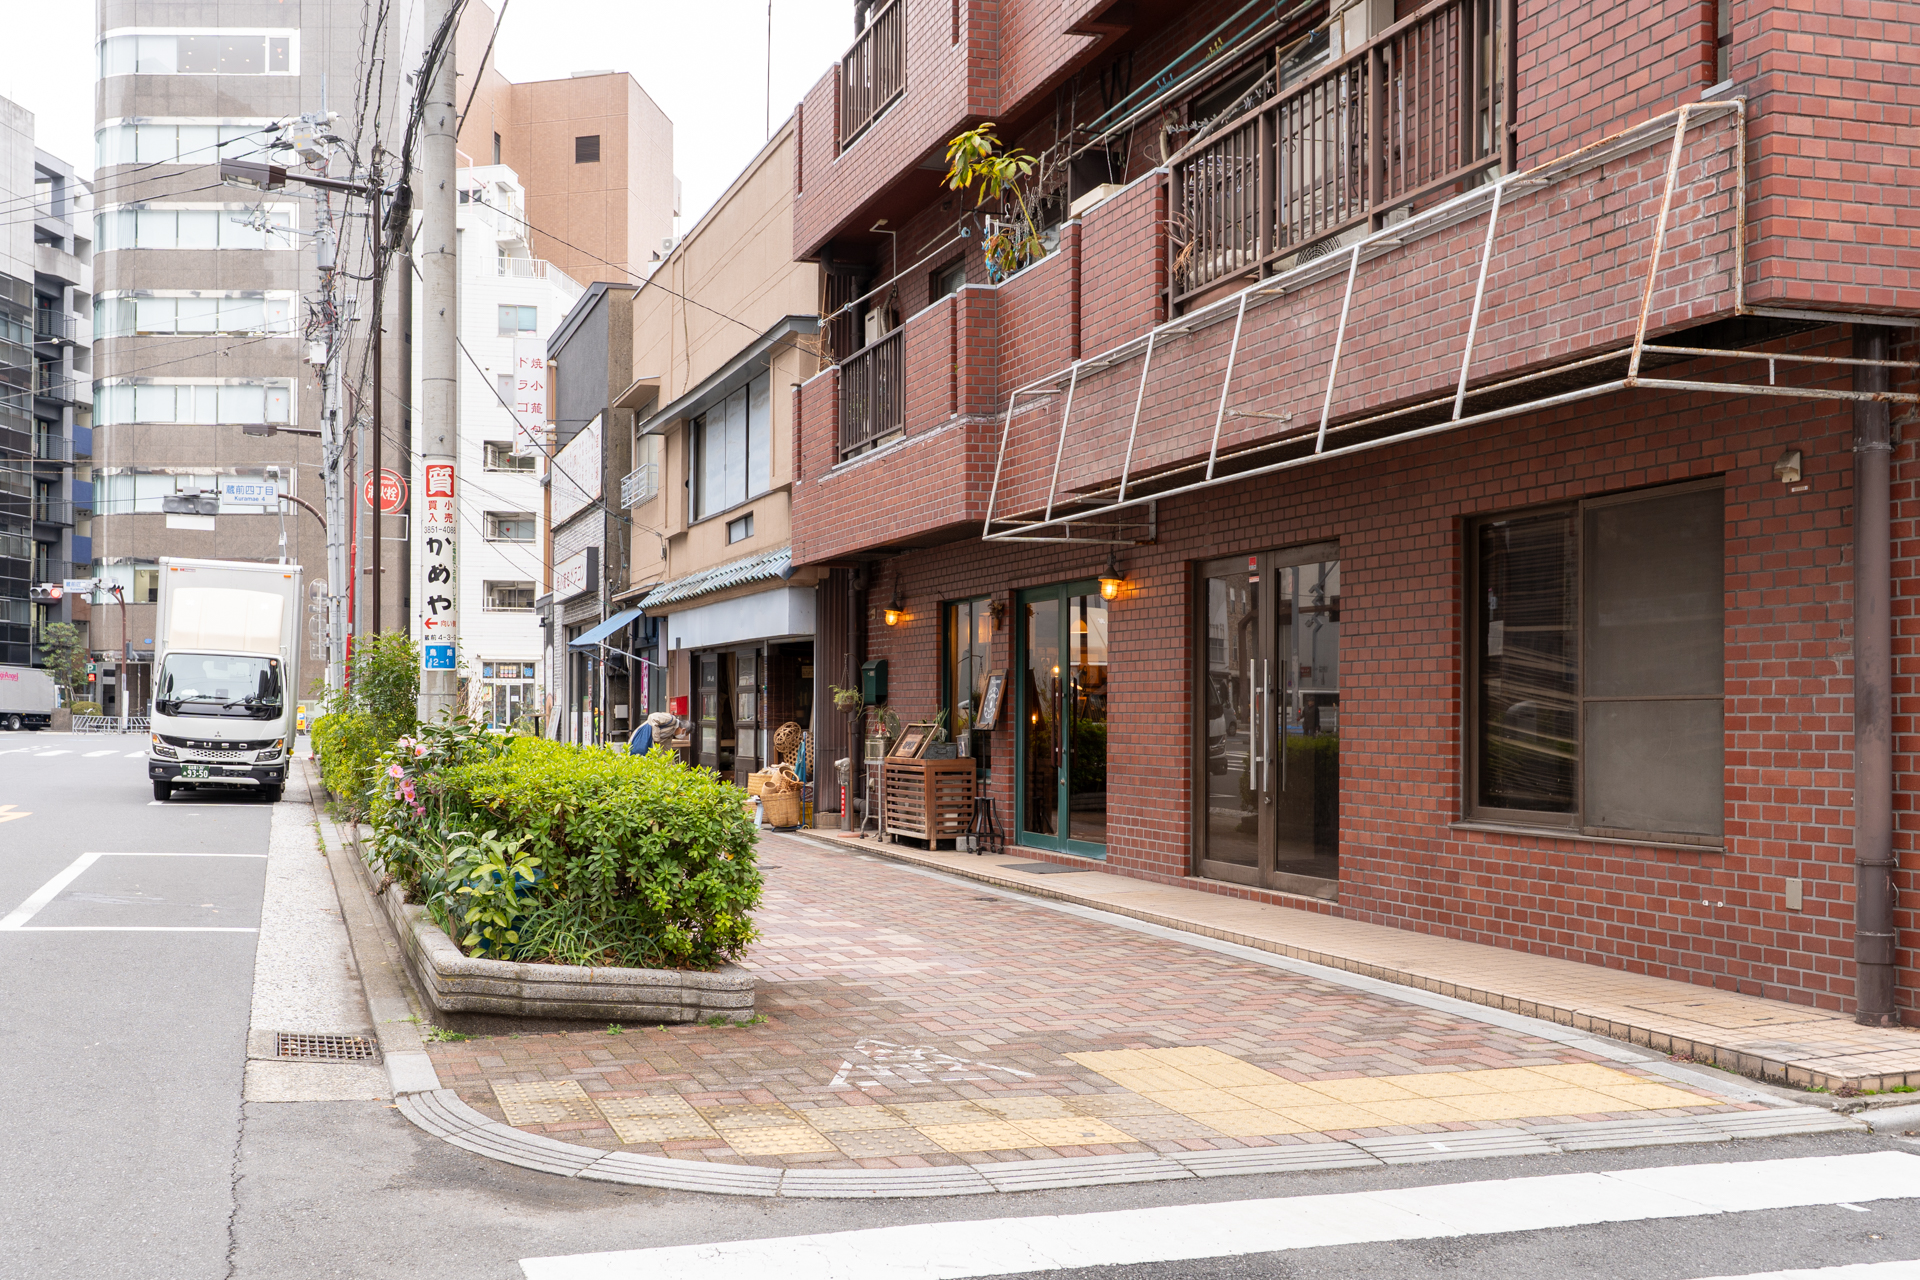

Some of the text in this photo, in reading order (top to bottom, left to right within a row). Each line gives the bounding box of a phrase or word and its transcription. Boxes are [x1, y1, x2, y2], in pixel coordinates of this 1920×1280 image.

[517, 356, 530, 436] ドラゴン
[226, 485, 274, 496] 蔵前四丁目
[428, 466, 452, 496] 質
[428, 500, 438, 523] 買入
[444, 500, 453, 524] 小売
[426, 537, 452, 615] かめや
[87, 664, 94, 674] P
[186, 741, 248, 749] FUSO
[187, 769, 209, 778] 93-50
